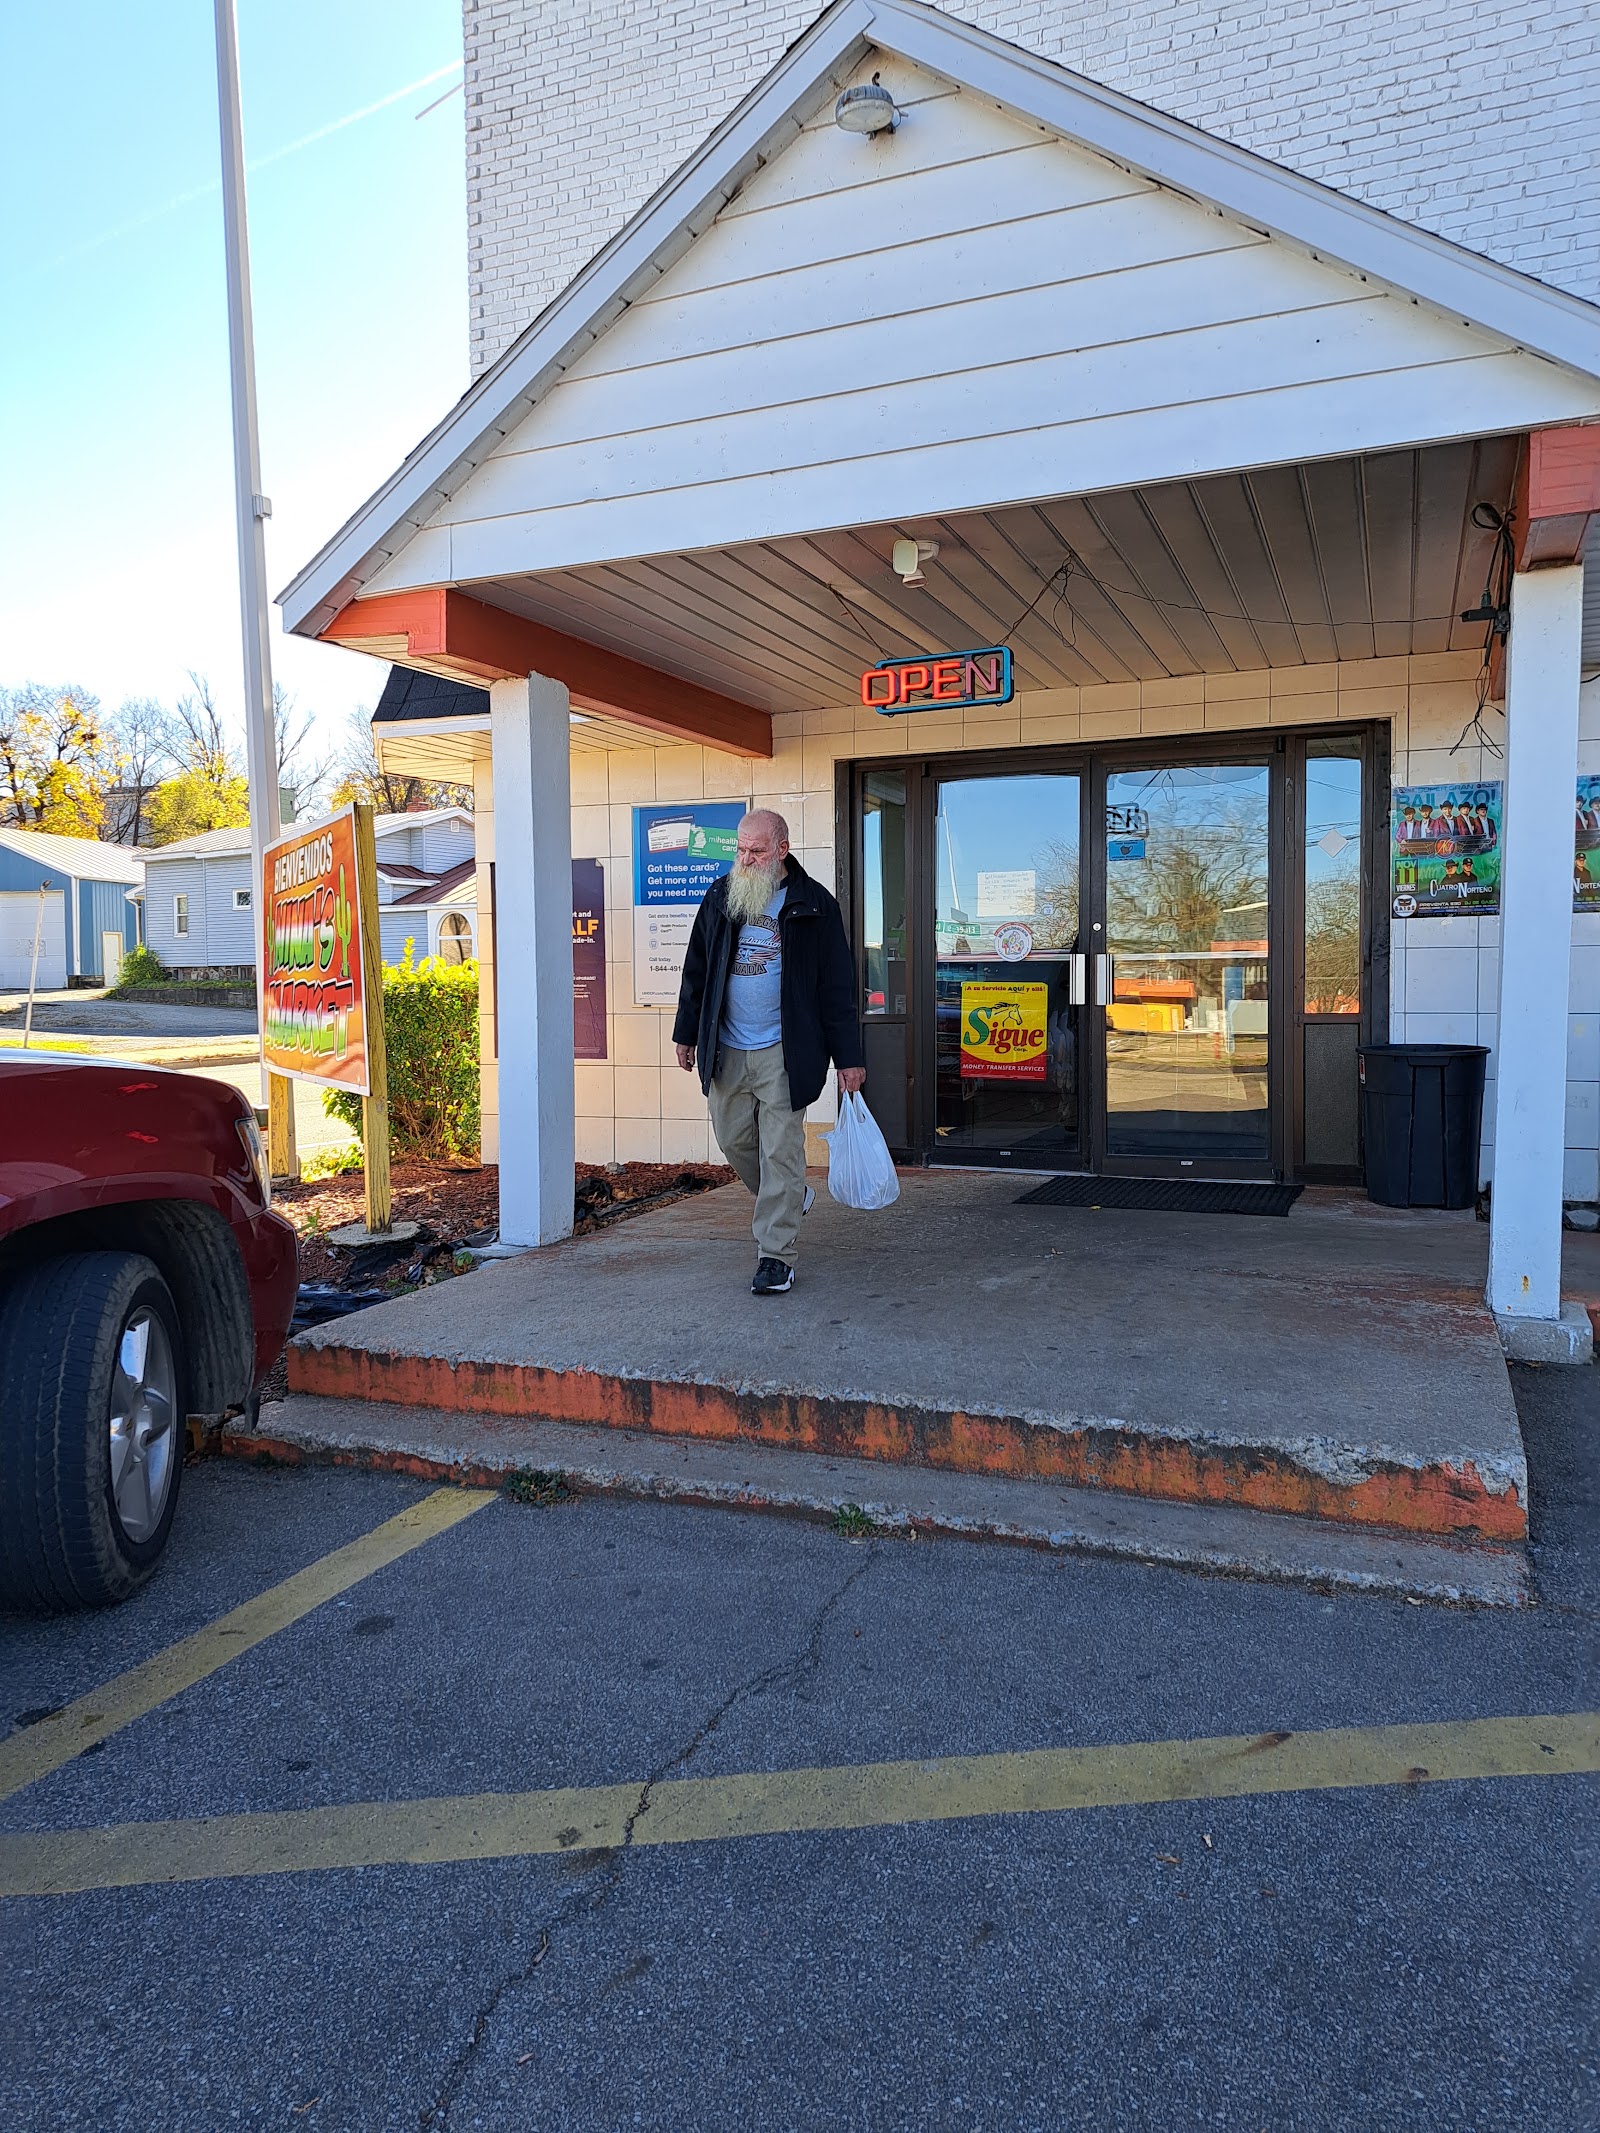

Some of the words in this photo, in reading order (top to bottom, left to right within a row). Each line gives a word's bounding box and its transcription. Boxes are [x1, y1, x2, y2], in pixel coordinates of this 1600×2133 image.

[861, 657, 998, 706] OPEN
[274, 830, 334, 895] BIENVENIDOS
[647, 864, 663, 873] Got
[664, 863, 688, 872] these
[690, 862, 720, 872] cards?
[1396, 859, 1417, 868] NOV
[1397, 868, 1415, 884] 11
[647, 876, 663, 885] Get
[664, 877, 687, 885] more
[689, 875, 698, 884] of
[700, 875, 714, 884] the
[647, 889, 663, 899] you
[665, 888, 686, 897] need
[273, 884, 335, 977] NINA'S
[266, 979, 354, 1061] MARKET
[963, 1006, 1045, 1055] Sigue
